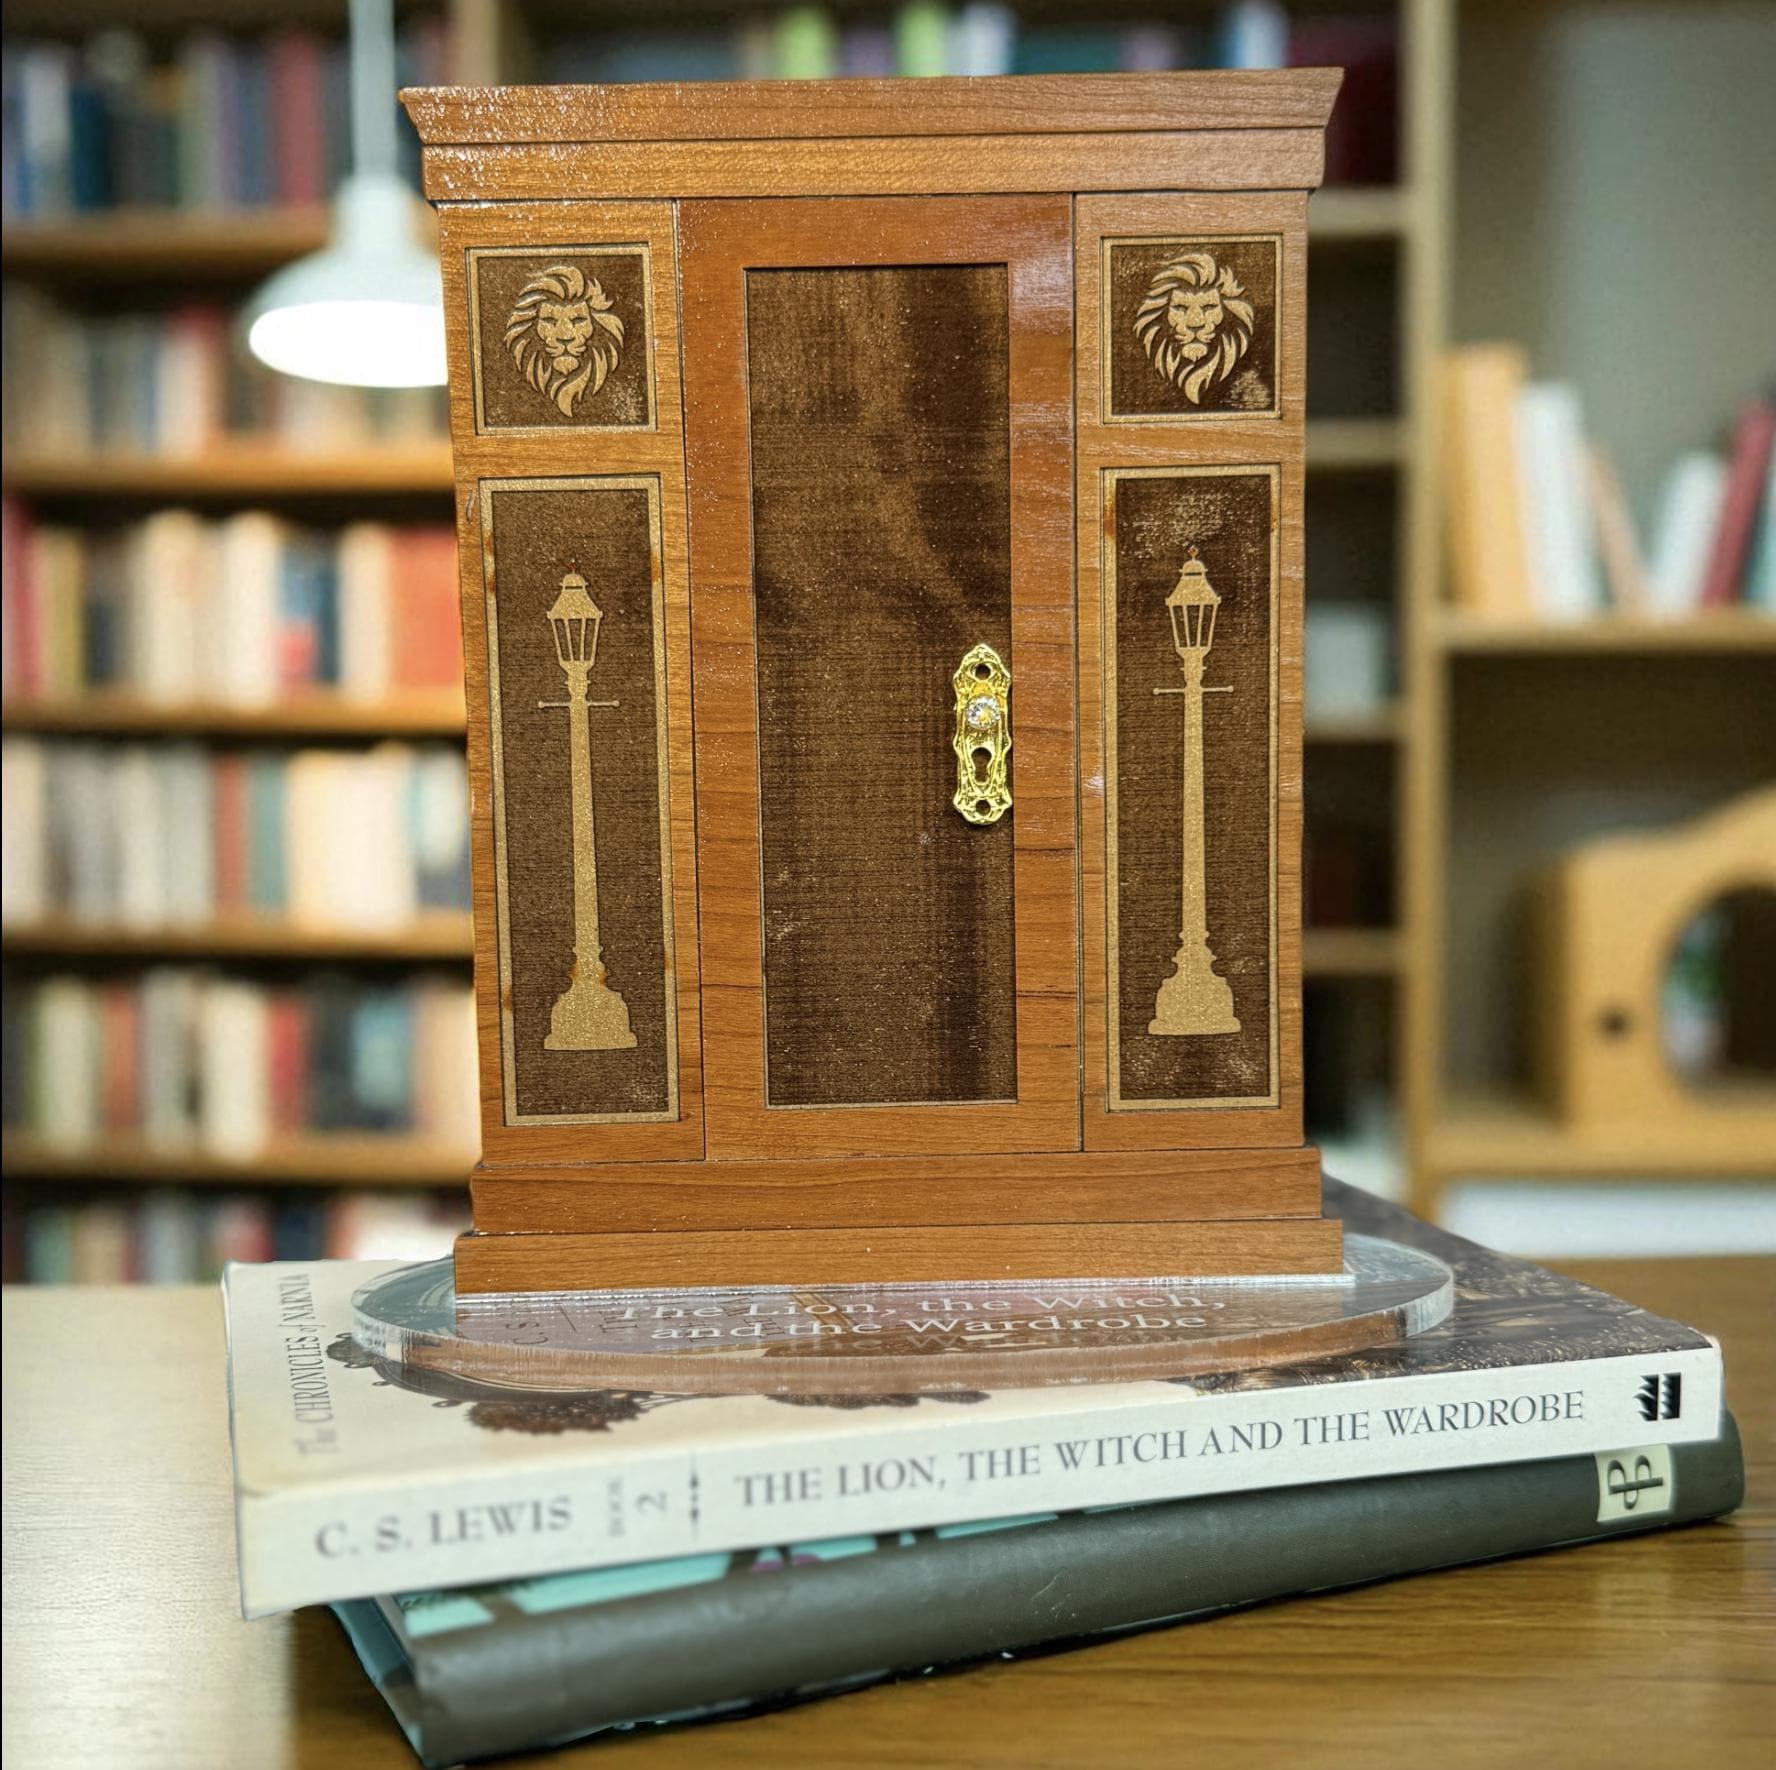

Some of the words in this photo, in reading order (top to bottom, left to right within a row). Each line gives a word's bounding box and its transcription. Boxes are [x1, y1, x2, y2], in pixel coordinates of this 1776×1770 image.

[279, 1274, 316, 1322] NARNIA
[617, 1303, 723, 1320] The
[747, 1300, 897, 1317] Lion,
[916, 1298, 1012, 1314] the
[1034, 1294, 1226, 1310] Witch,
[651, 1321, 766, 1339] and
[786, 1320, 883, 1336] the
[900, 1314, 1208, 1334] Wardrobe
[286, 1335, 334, 1424] CHRONICLES
[734, 1467, 824, 1508] THE
[837, 1456, 947, 1497] LION,
[958, 1443, 1042, 1482] THE
[1054, 1426, 1187, 1470] WITCH
[1197, 1420, 1284, 1457] AND
[1294, 1410, 1371, 1447] THE
[1382, 1390, 1585, 1438] WARDROBE
[634, 1490, 668, 1516] 2
[315, 1521, 360, 1559] C.
[375, 1515, 413, 1553] S.
[429, 1496, 573, 1546] LEWIS
